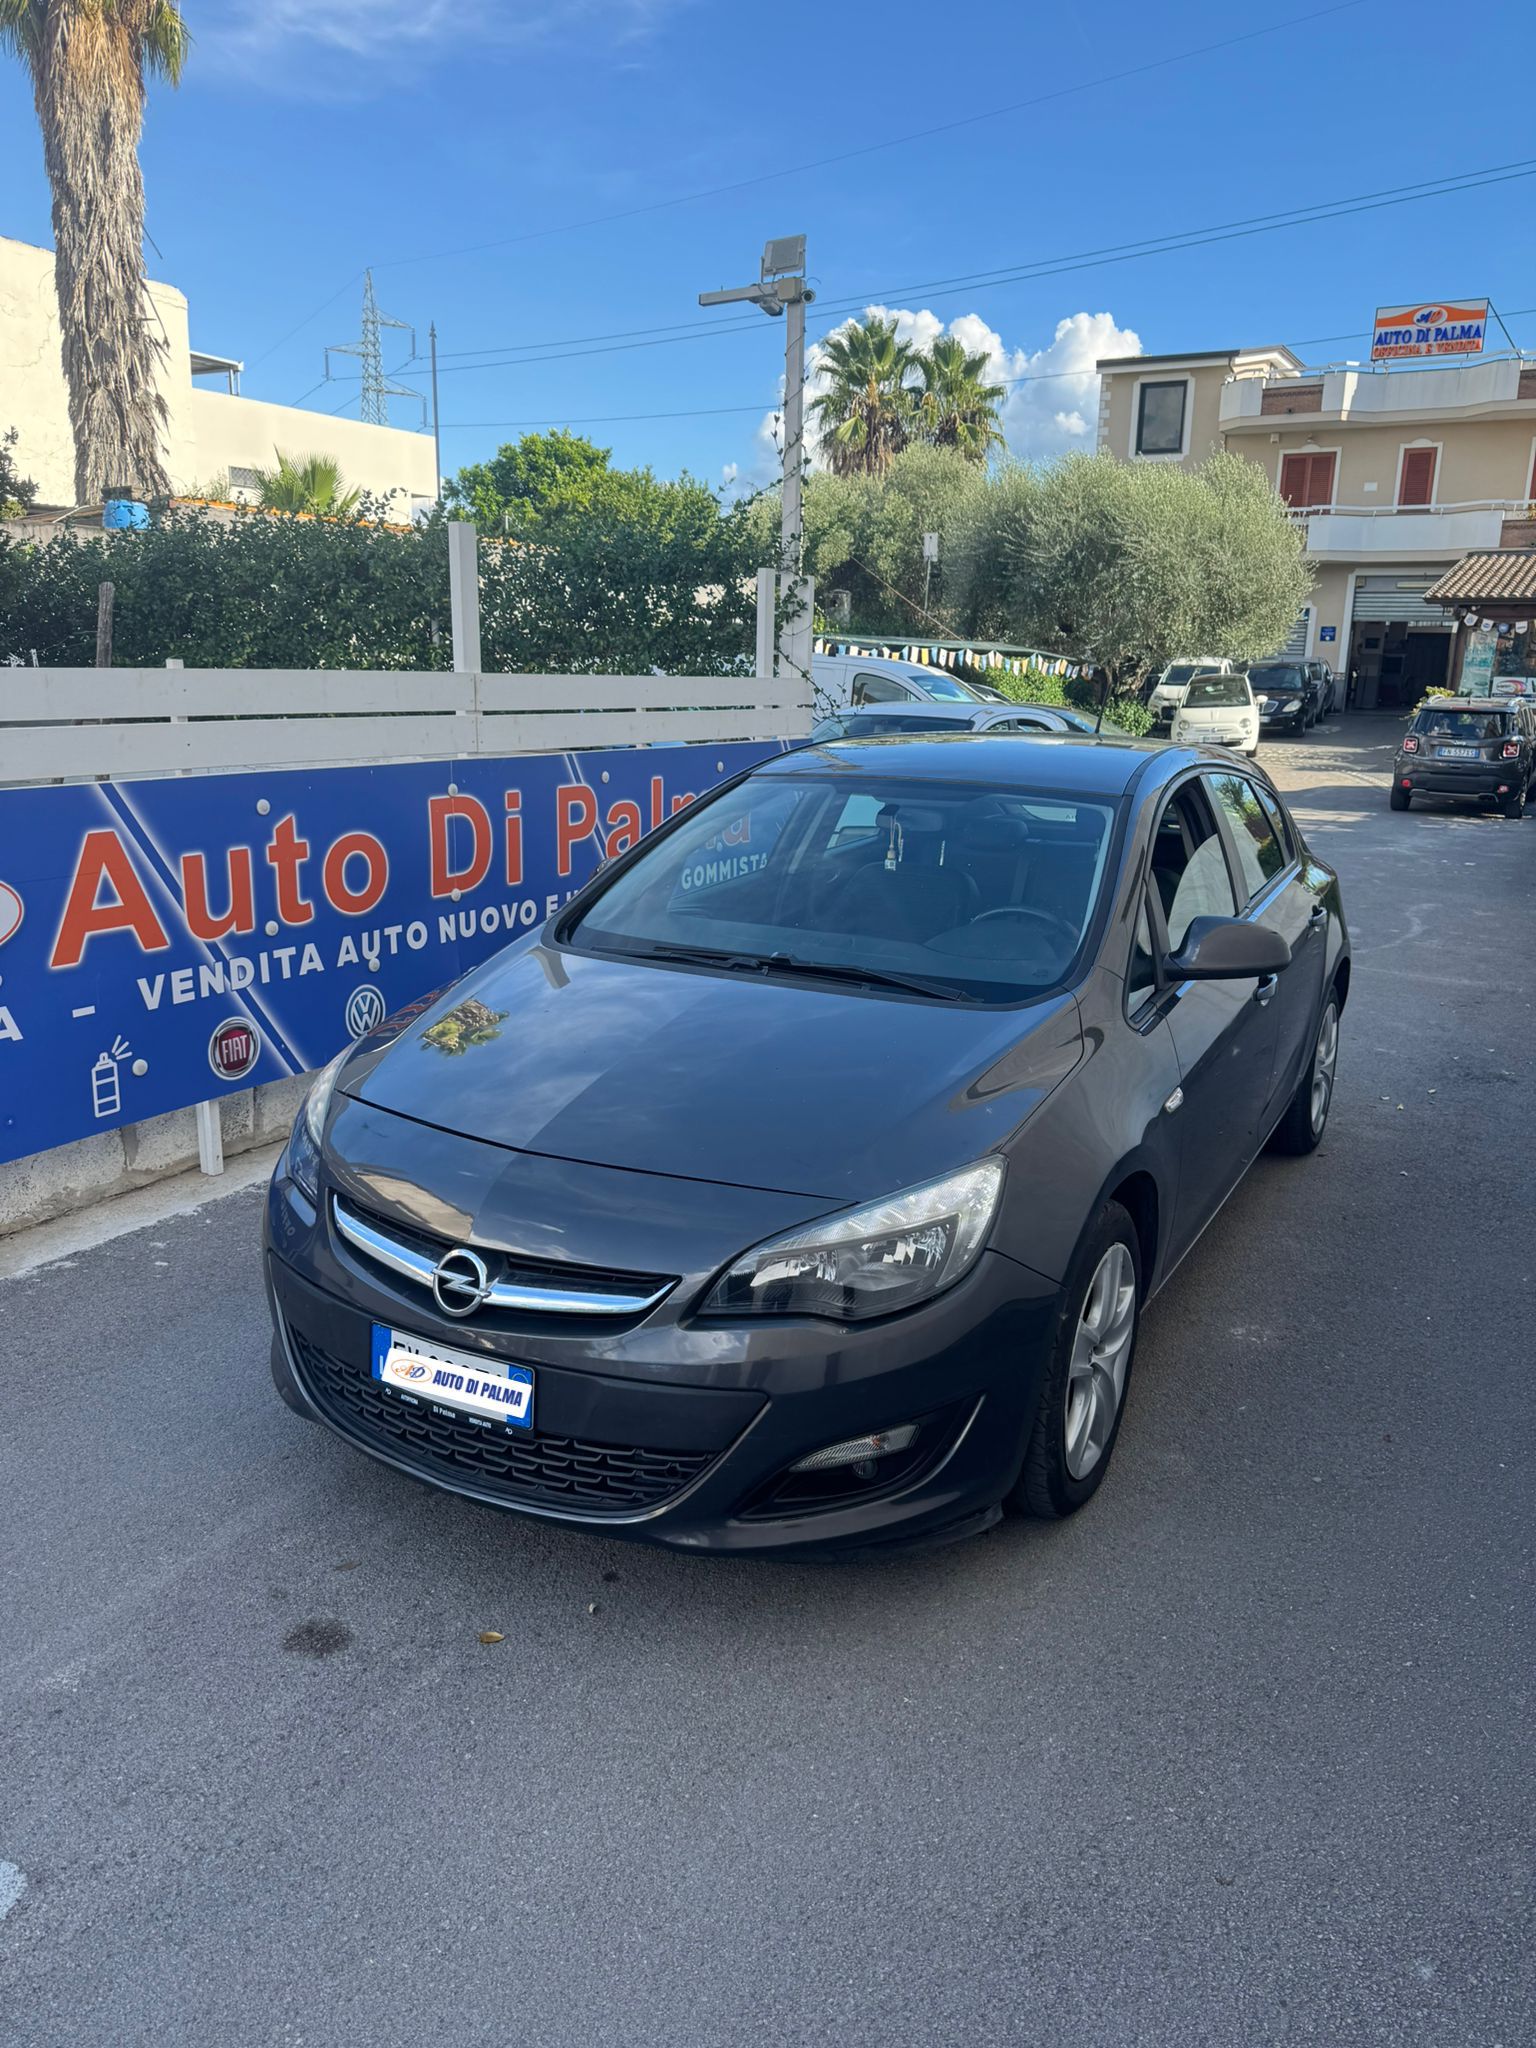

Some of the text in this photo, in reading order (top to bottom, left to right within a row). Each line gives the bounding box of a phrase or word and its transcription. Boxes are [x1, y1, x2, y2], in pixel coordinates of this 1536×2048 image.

[1375, 324, 1482, 346] AUTO DI PALMA
[50, 813, 315, 969] Auto
[429, 790, 523, 898] Di
[136, 942, 325, 1011] VENDITA
[336, 920, 428, 968] AUTO
[438, 899, 538, 944] NUOVO
[681, 852, 768, 890] GOMMISTA
[221, 1034, 249, 1065] FIAT
